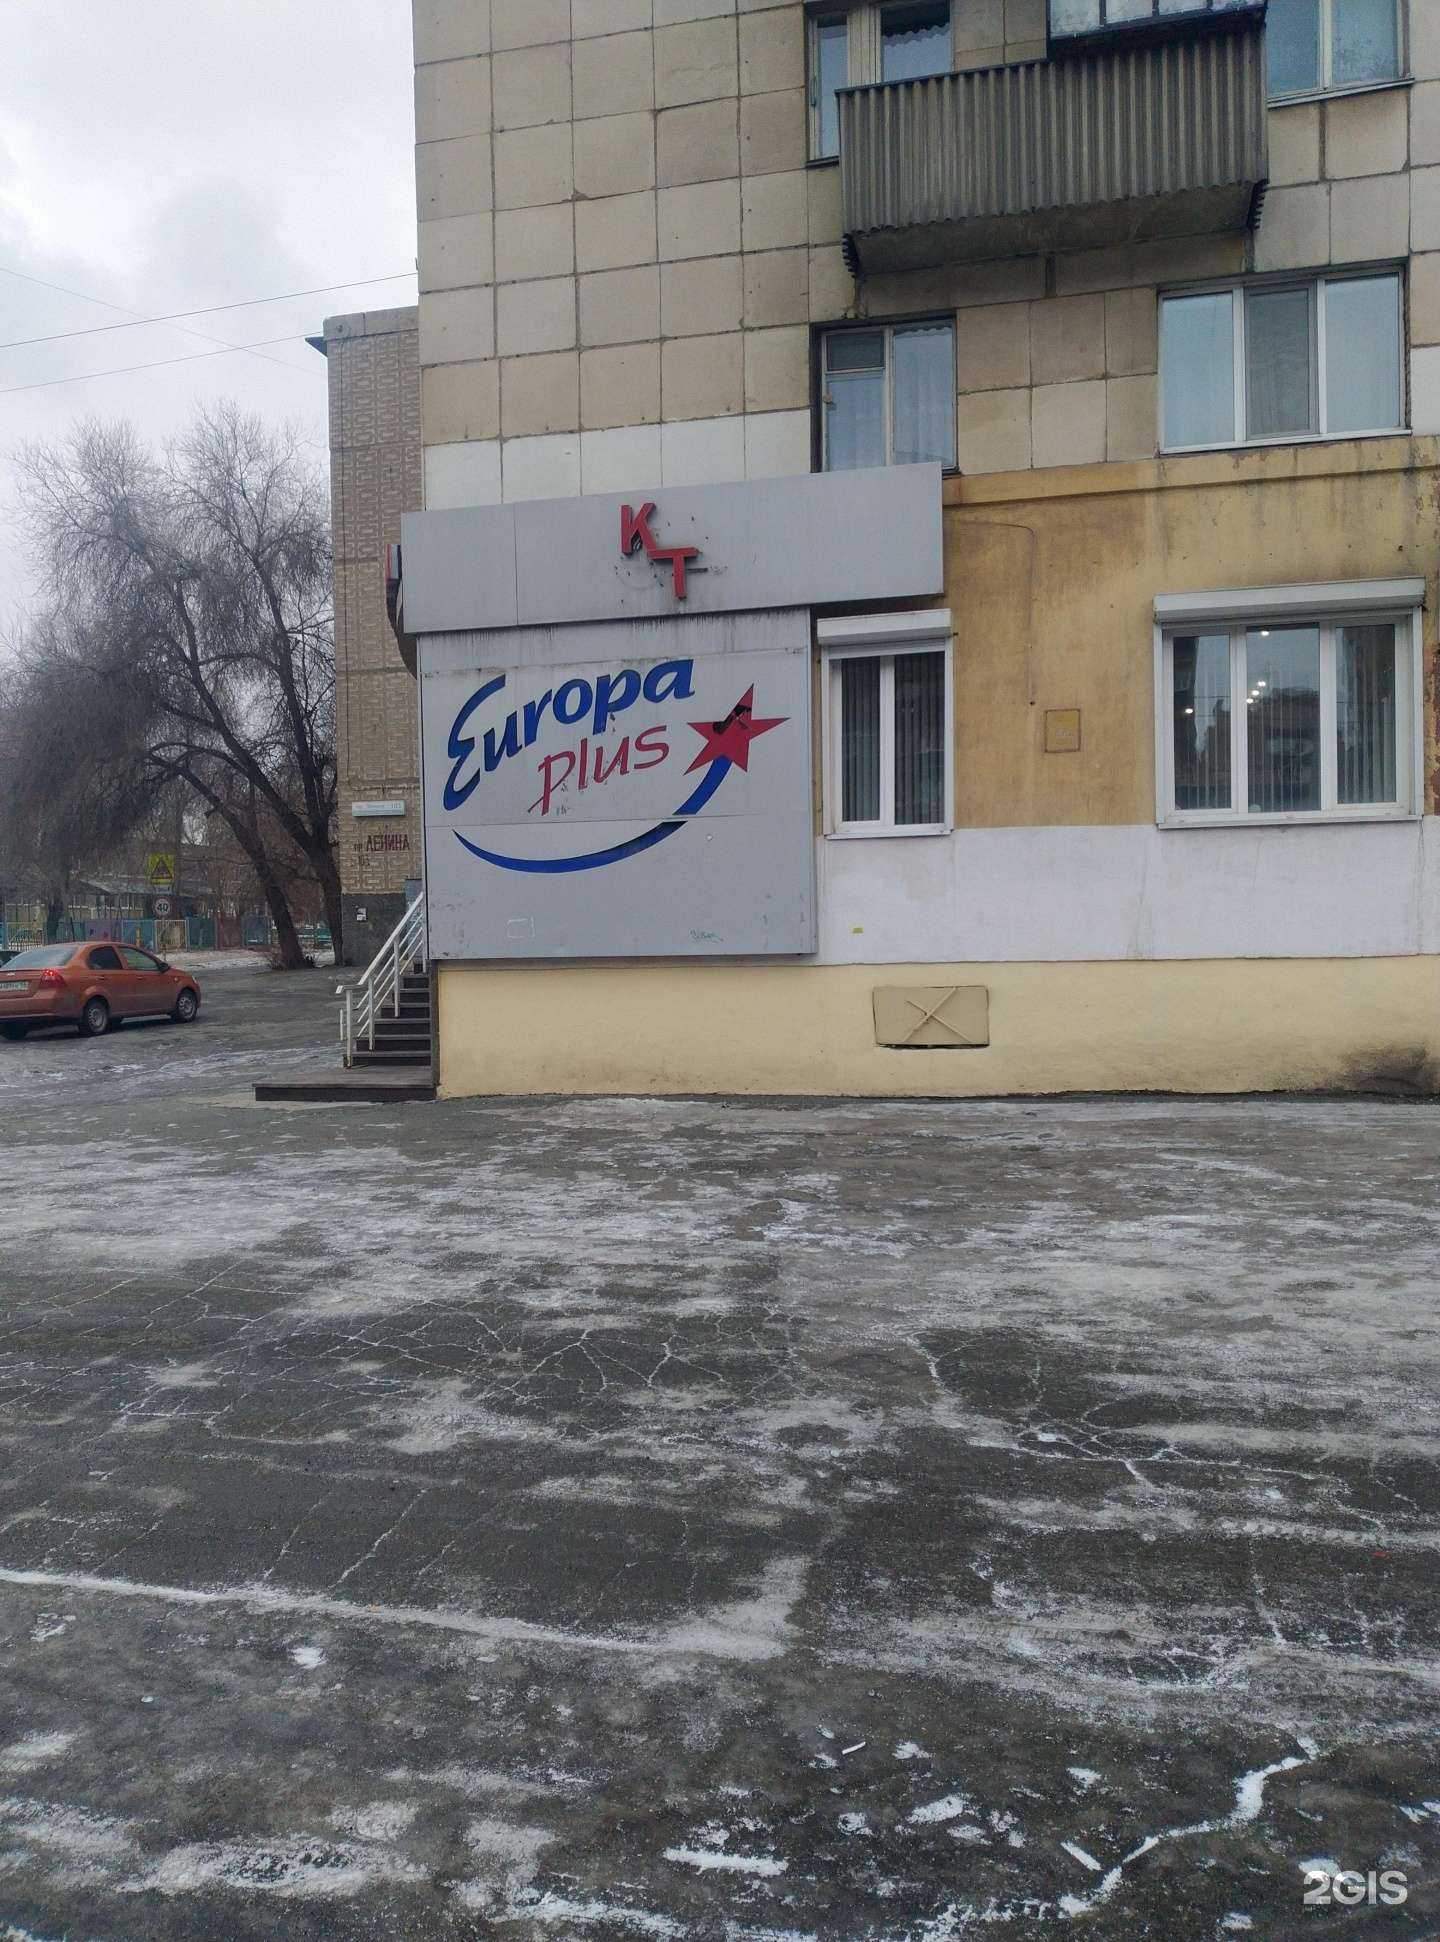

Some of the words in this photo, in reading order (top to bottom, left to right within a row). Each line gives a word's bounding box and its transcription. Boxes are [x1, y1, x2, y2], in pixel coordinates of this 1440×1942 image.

[442, 658, 696, 812] Europa
[527, 725, 670, 816] plus
[366, 834, 410, 852] ЛЕНИНА
[156, 903, 169, 912] 40
